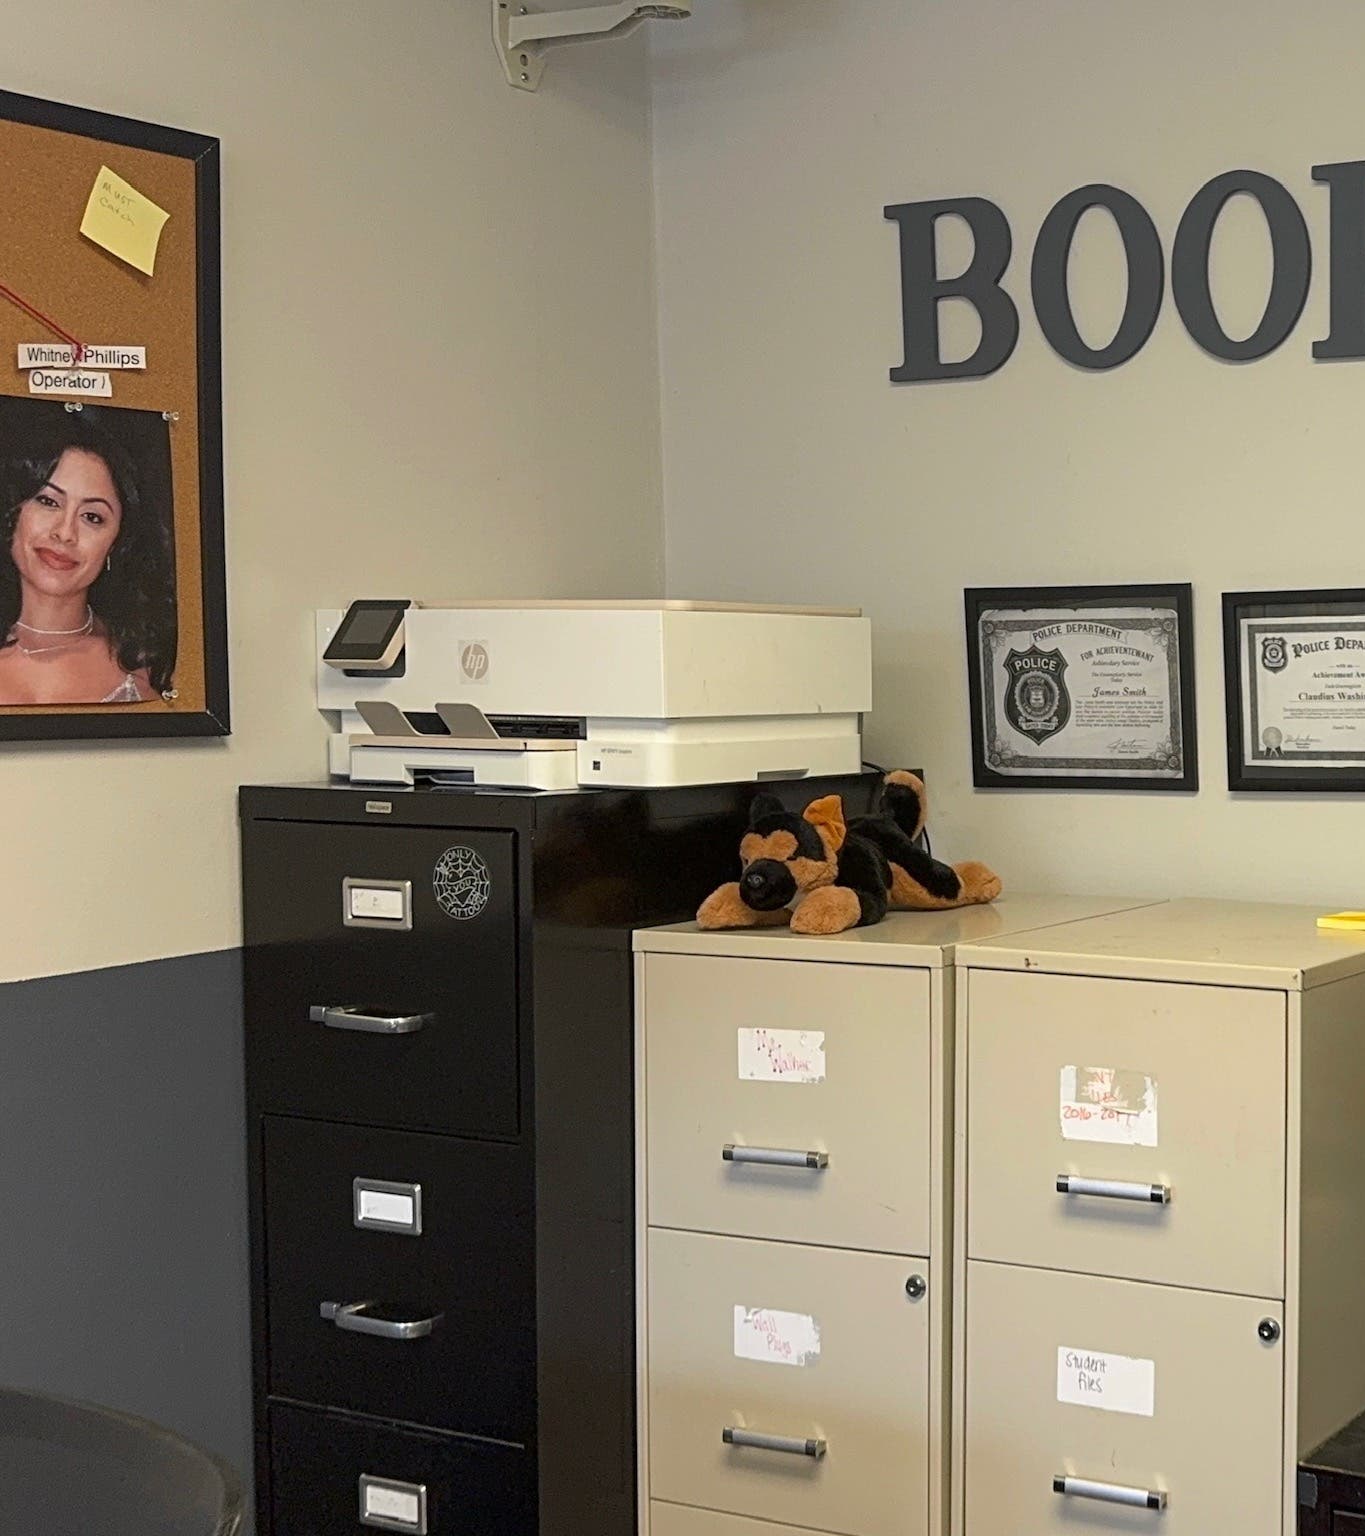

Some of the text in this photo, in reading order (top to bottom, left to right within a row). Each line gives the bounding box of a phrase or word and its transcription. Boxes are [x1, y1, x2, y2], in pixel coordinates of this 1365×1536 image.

[27, 347, 141, 367] Whitney Phillips
[31, 370, 97, 390] Operator
[1032, 623, 1122, 642] POLICE DEPARTMENT
[462, 643, 488, 680] hp
[1014, 657, 1058, 672] POLICE
[1092, 686, 1147, 698] James Smith
[446, 849, 472, 860] ONLY
[1065, 1352, 1106, 1374] Student
